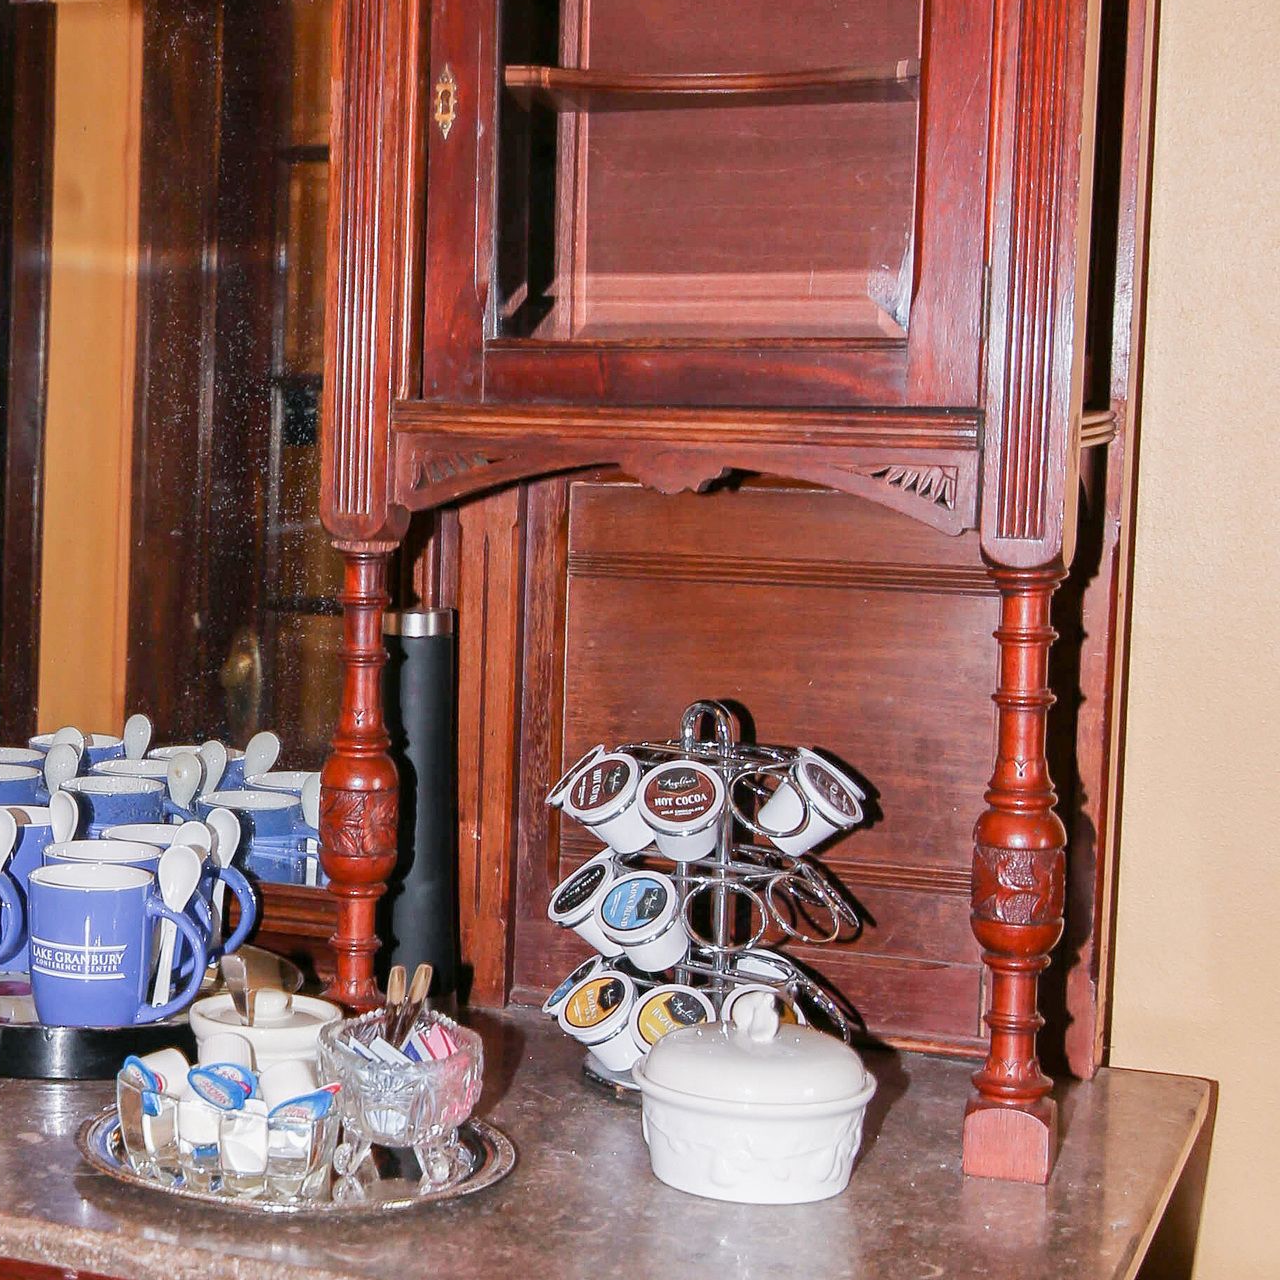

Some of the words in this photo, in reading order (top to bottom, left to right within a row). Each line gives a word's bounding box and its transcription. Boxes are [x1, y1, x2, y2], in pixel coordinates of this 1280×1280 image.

[654, 798, 673, 806] HOT
[675, 794, 708, 806] COCOA
[33, 945, 52, 960] LAKE
[54, 951, 124, 966] GRANBURY
[35, 958, 81, 972] CONFERENCE
